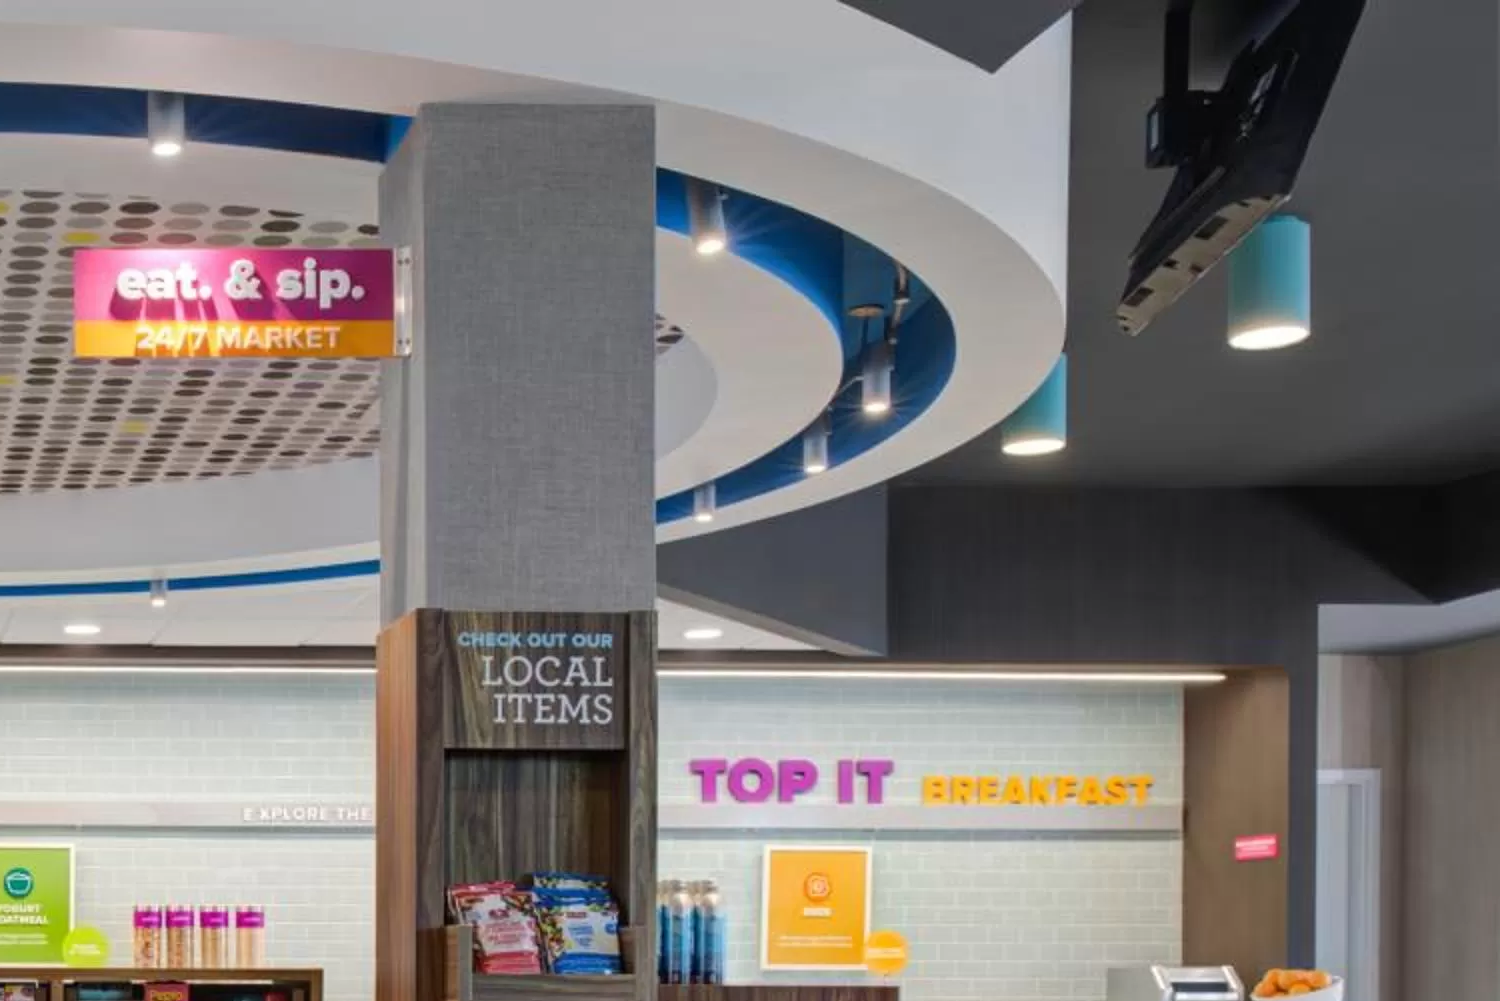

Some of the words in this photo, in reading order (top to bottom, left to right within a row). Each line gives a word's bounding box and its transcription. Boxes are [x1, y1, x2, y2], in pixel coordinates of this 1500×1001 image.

[116, 261, 212, 300] eat.
[224, 259, 263, 300] &
[276, 257, 365, 309] sip.
[136, 326, 206, 350] 24/7
[216, 326, 341, 350] MARKET
[457, 631, 522, 648] CHECK
[526, 632, 567, 648] OUT
[571, 633, 613, 648] OUR
[481, 655, 613, 687] LOCAL
[492, 693, 613, 725] ITEMS
[690, 758, 819, 804] TOP
[837, 759, 895, 804] IT
[921, 775, 1156, 808] BREAKFAST
[337, 806, 373, 821] THE
